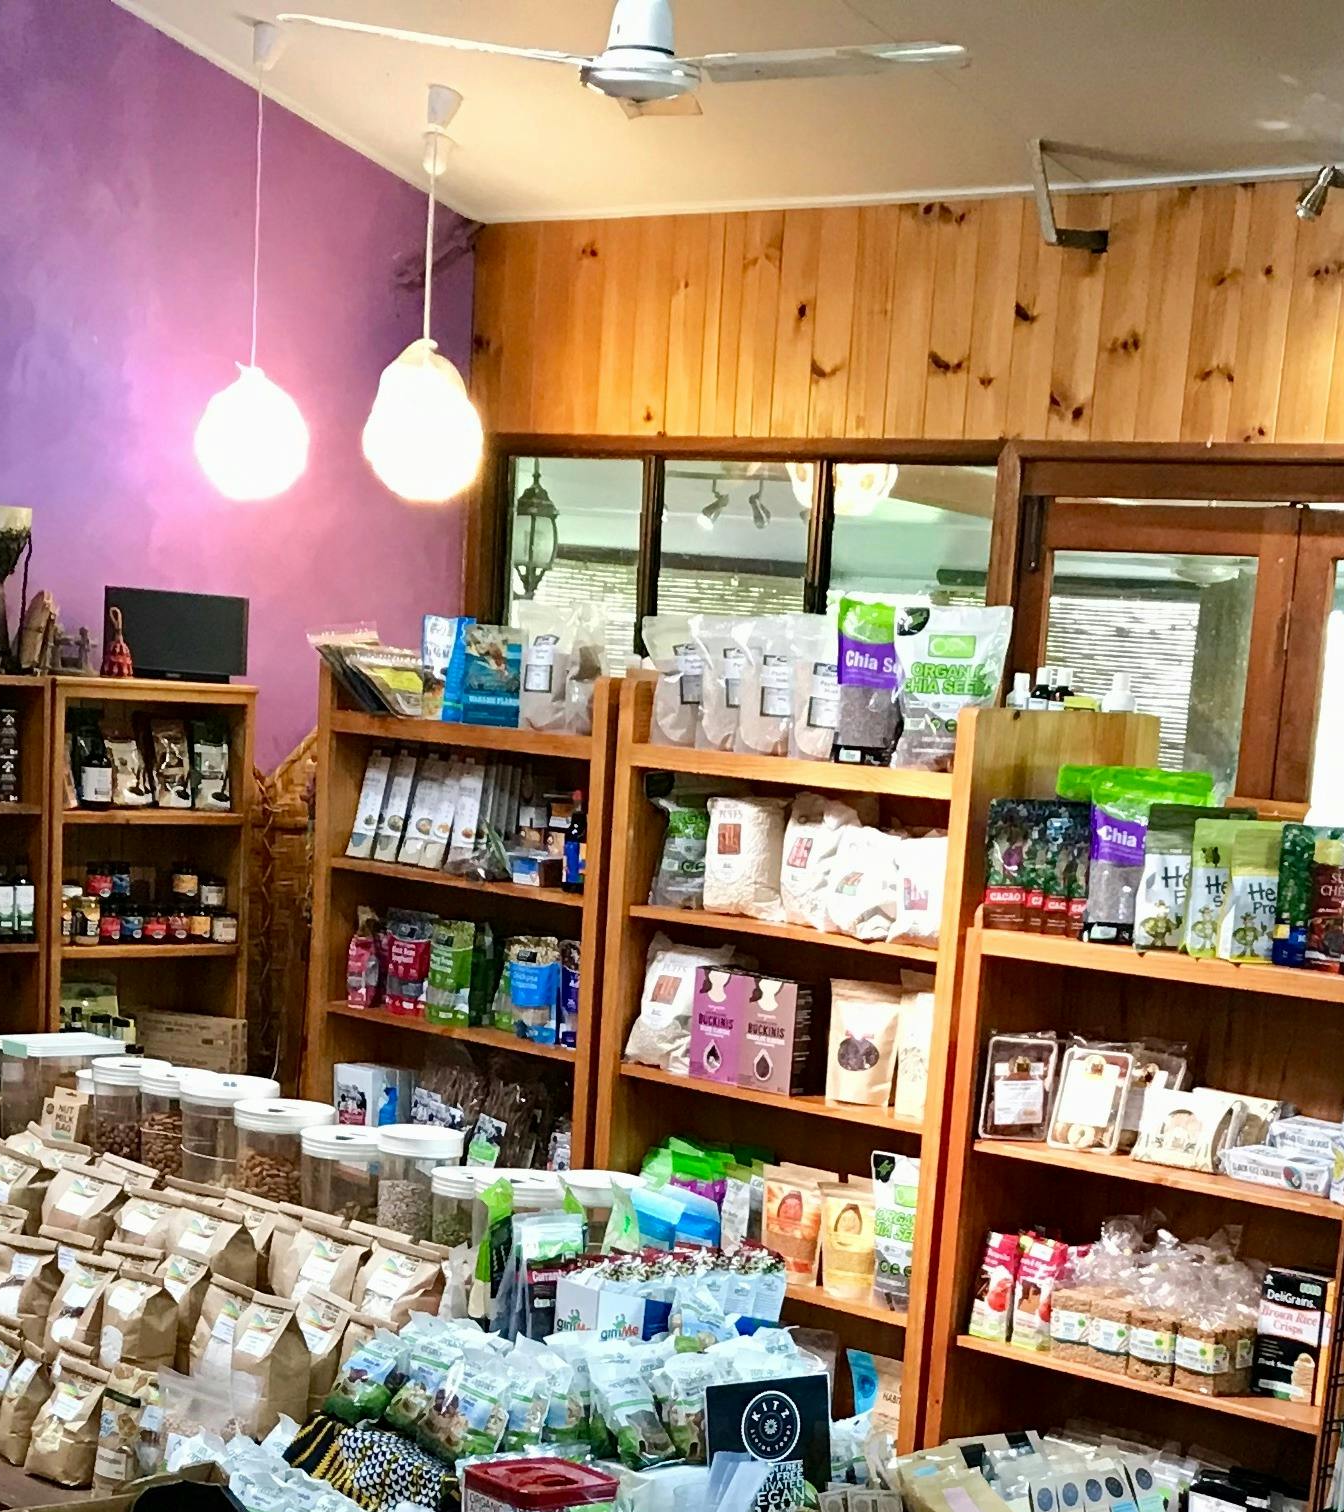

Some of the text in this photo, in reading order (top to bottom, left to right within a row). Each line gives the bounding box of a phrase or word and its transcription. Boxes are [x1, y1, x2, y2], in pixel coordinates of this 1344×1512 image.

[846, 650, 879, 671] Chia
[1101, 825, 1137, 848] Chia
[990, 891, 1021, 902] CACAO
[600, 1323, 639, 1341] gimMe
[751, 1400, 790, 1422] KITZ
[776, 1471, 804, 1481] FREE
[756, 1487, 805, 1506] EGAN
